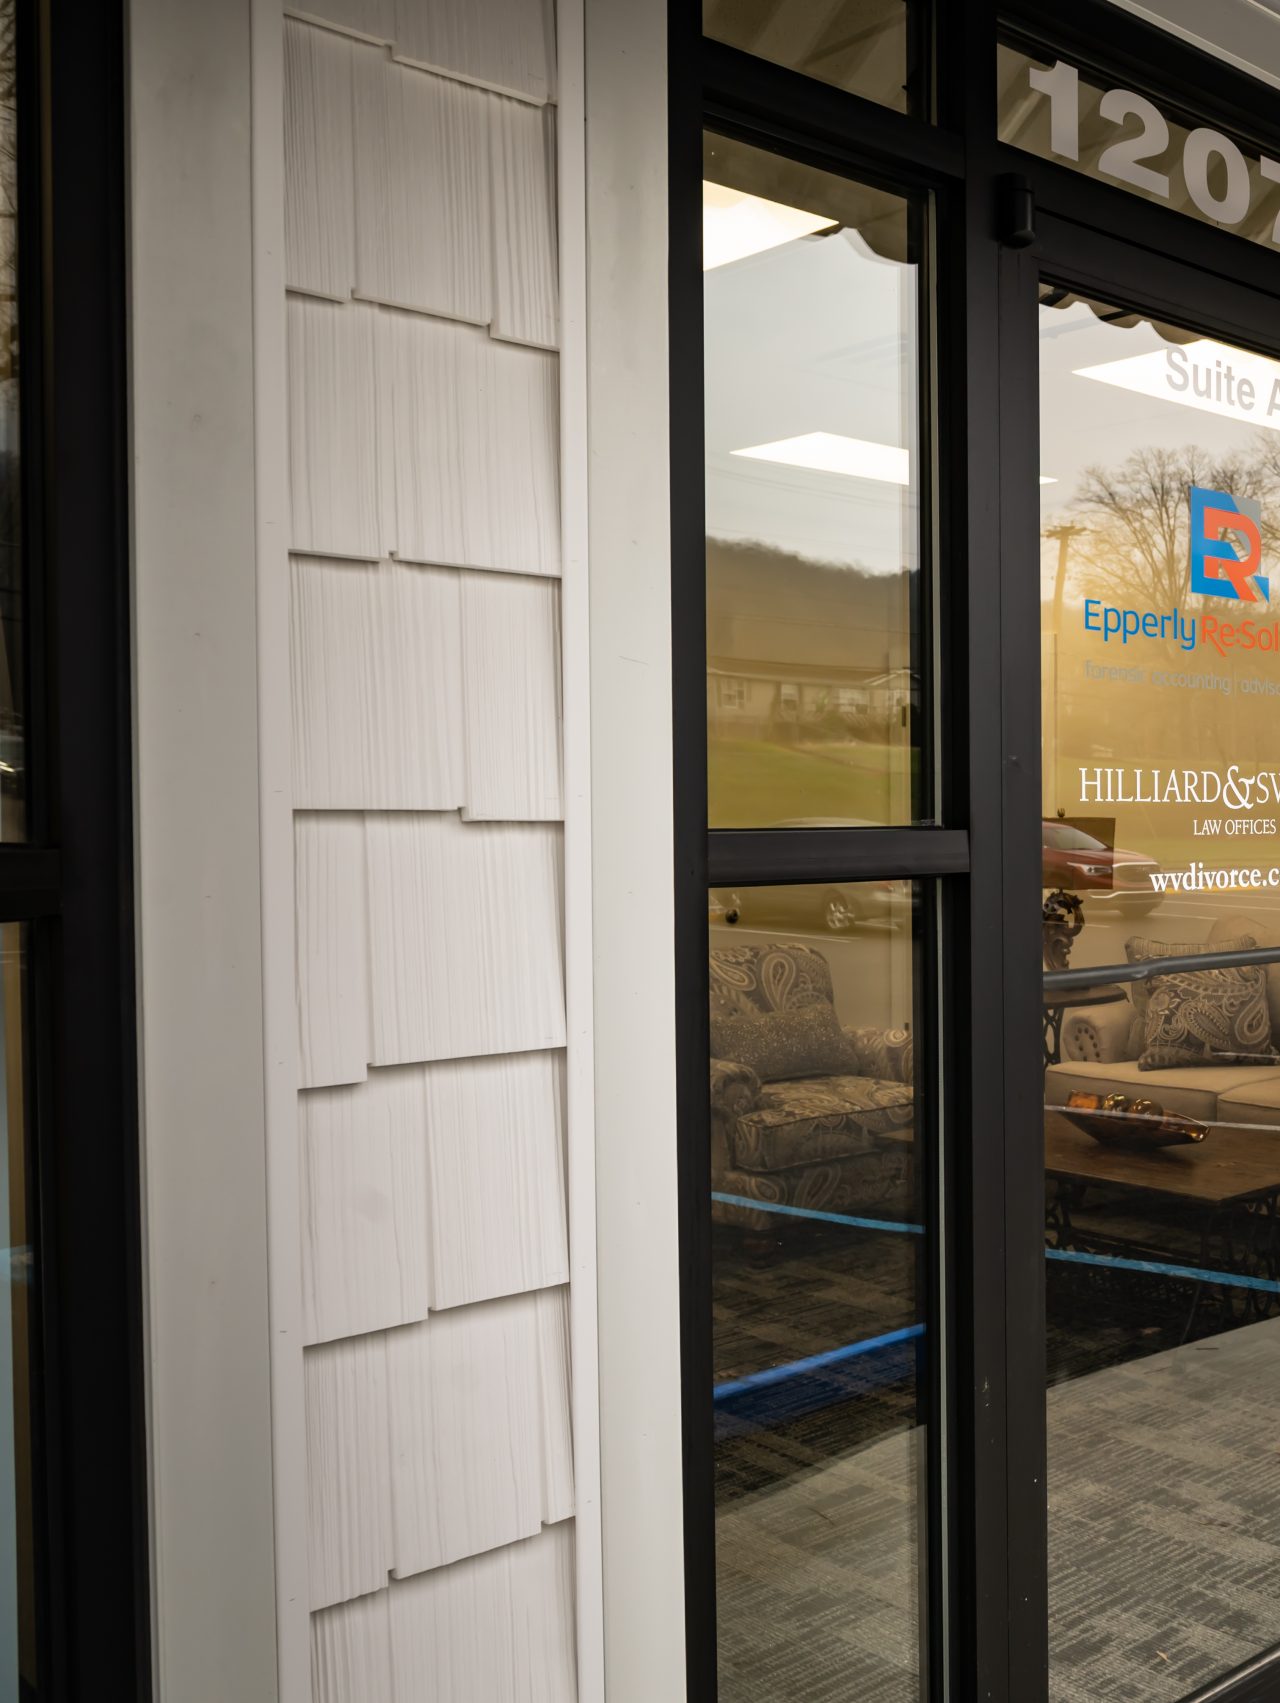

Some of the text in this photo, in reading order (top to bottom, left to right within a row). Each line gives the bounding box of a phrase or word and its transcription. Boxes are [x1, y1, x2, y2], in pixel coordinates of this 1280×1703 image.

[1165, 345, 1256, 411] Suite
[1084, 598, 1196, 651] Epperly
[1193, 818, 1277, 836] LAW OFFICES
